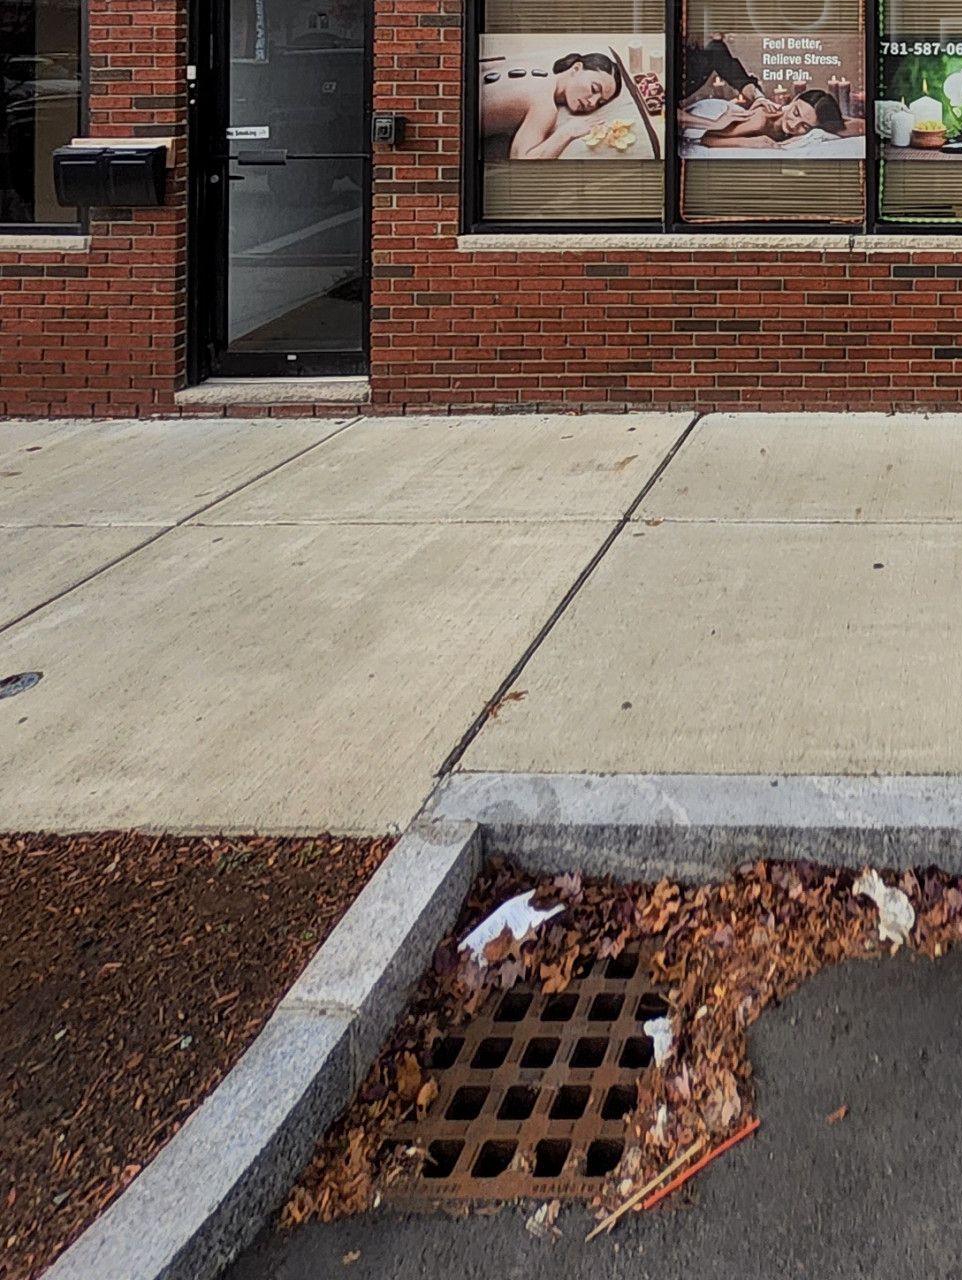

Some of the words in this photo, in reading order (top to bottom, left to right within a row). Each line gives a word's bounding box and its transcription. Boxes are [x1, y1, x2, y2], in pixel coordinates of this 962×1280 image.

[763, 38, 785, 50] Feel
[787, 38, 823, 51] Better,
[763, 53, 802, 65] Relieve
[804, 53, 841, 67] Stress,
[763, 69, 783, 81] End
[785, 69, 813, 81] Pain.
